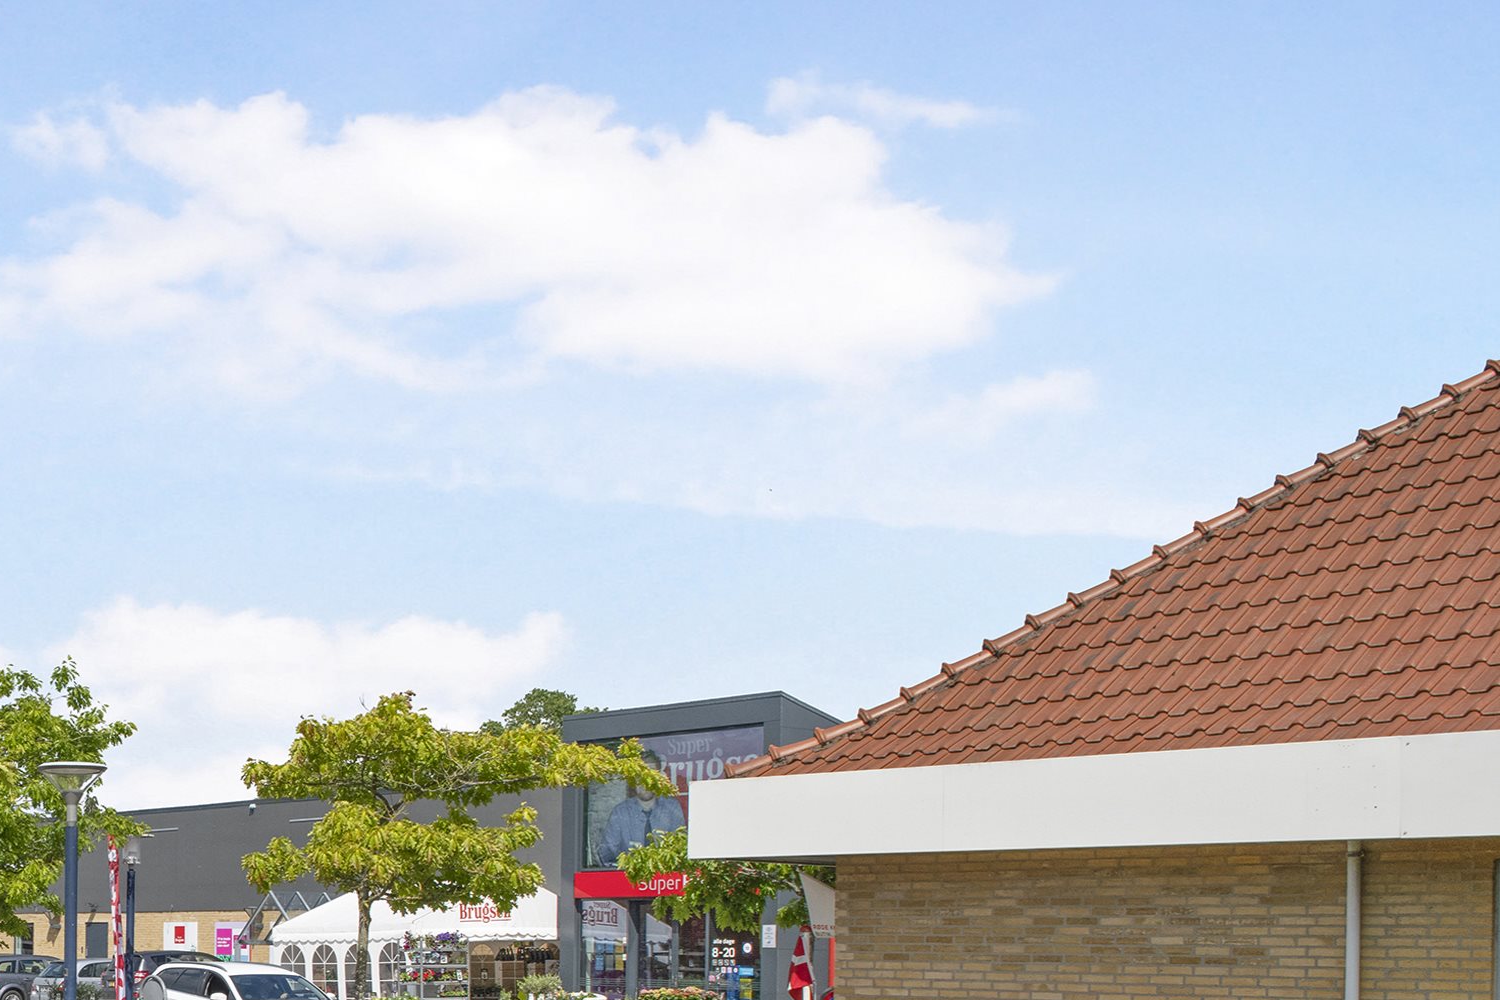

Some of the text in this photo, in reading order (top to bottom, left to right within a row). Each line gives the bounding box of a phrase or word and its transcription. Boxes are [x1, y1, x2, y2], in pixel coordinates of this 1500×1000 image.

[668, 738, 712, 758] Super
[657, 748, 758, 788] Brugs
[711, 947, 736, 958] 8-20
